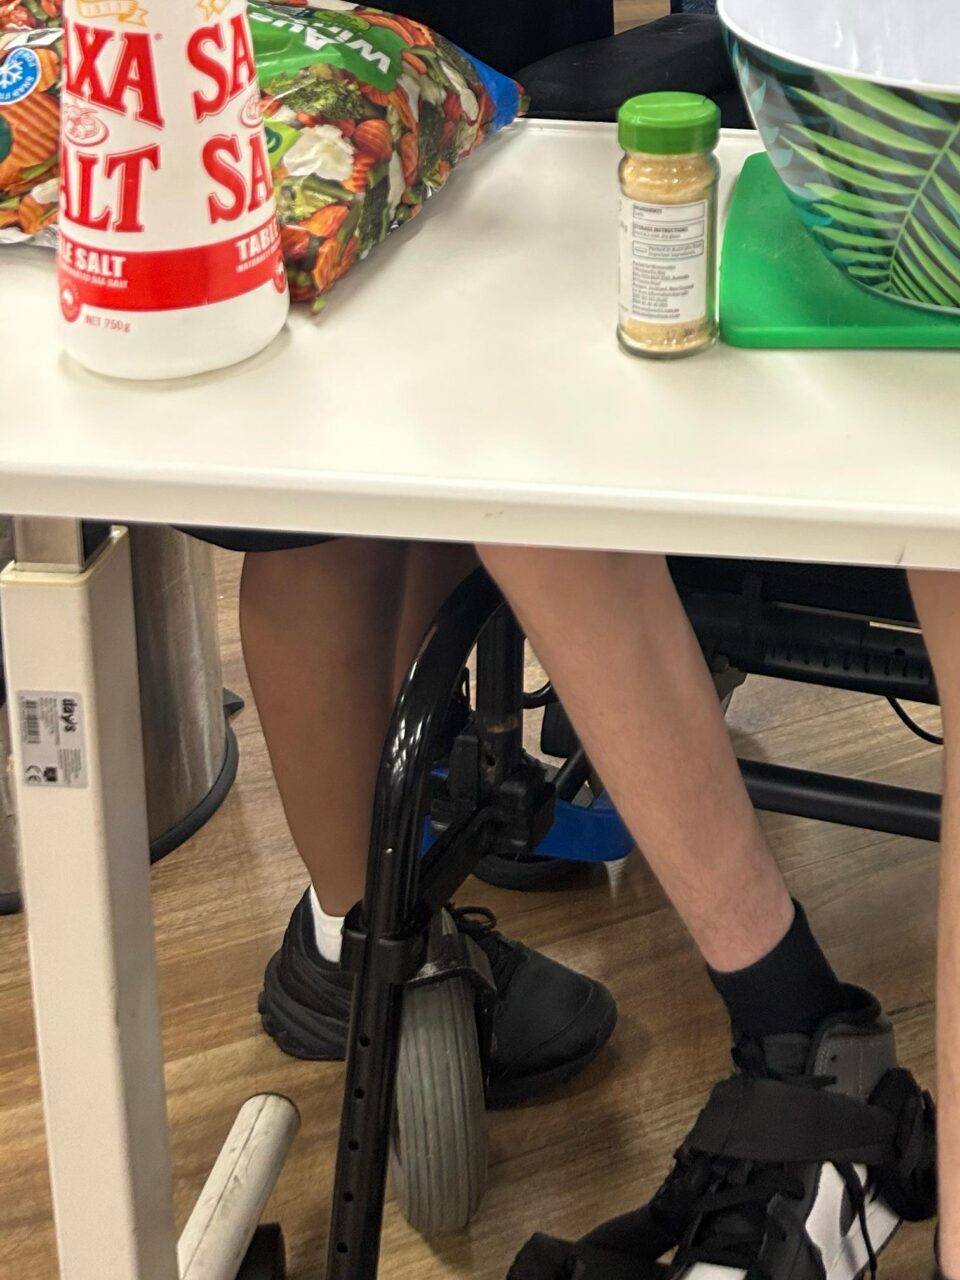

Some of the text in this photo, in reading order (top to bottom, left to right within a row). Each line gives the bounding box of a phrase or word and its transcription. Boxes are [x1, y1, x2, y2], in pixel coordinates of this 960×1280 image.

[75, 247, 126, 278] SALT
[85, 314, 131, 333] NET 750g
